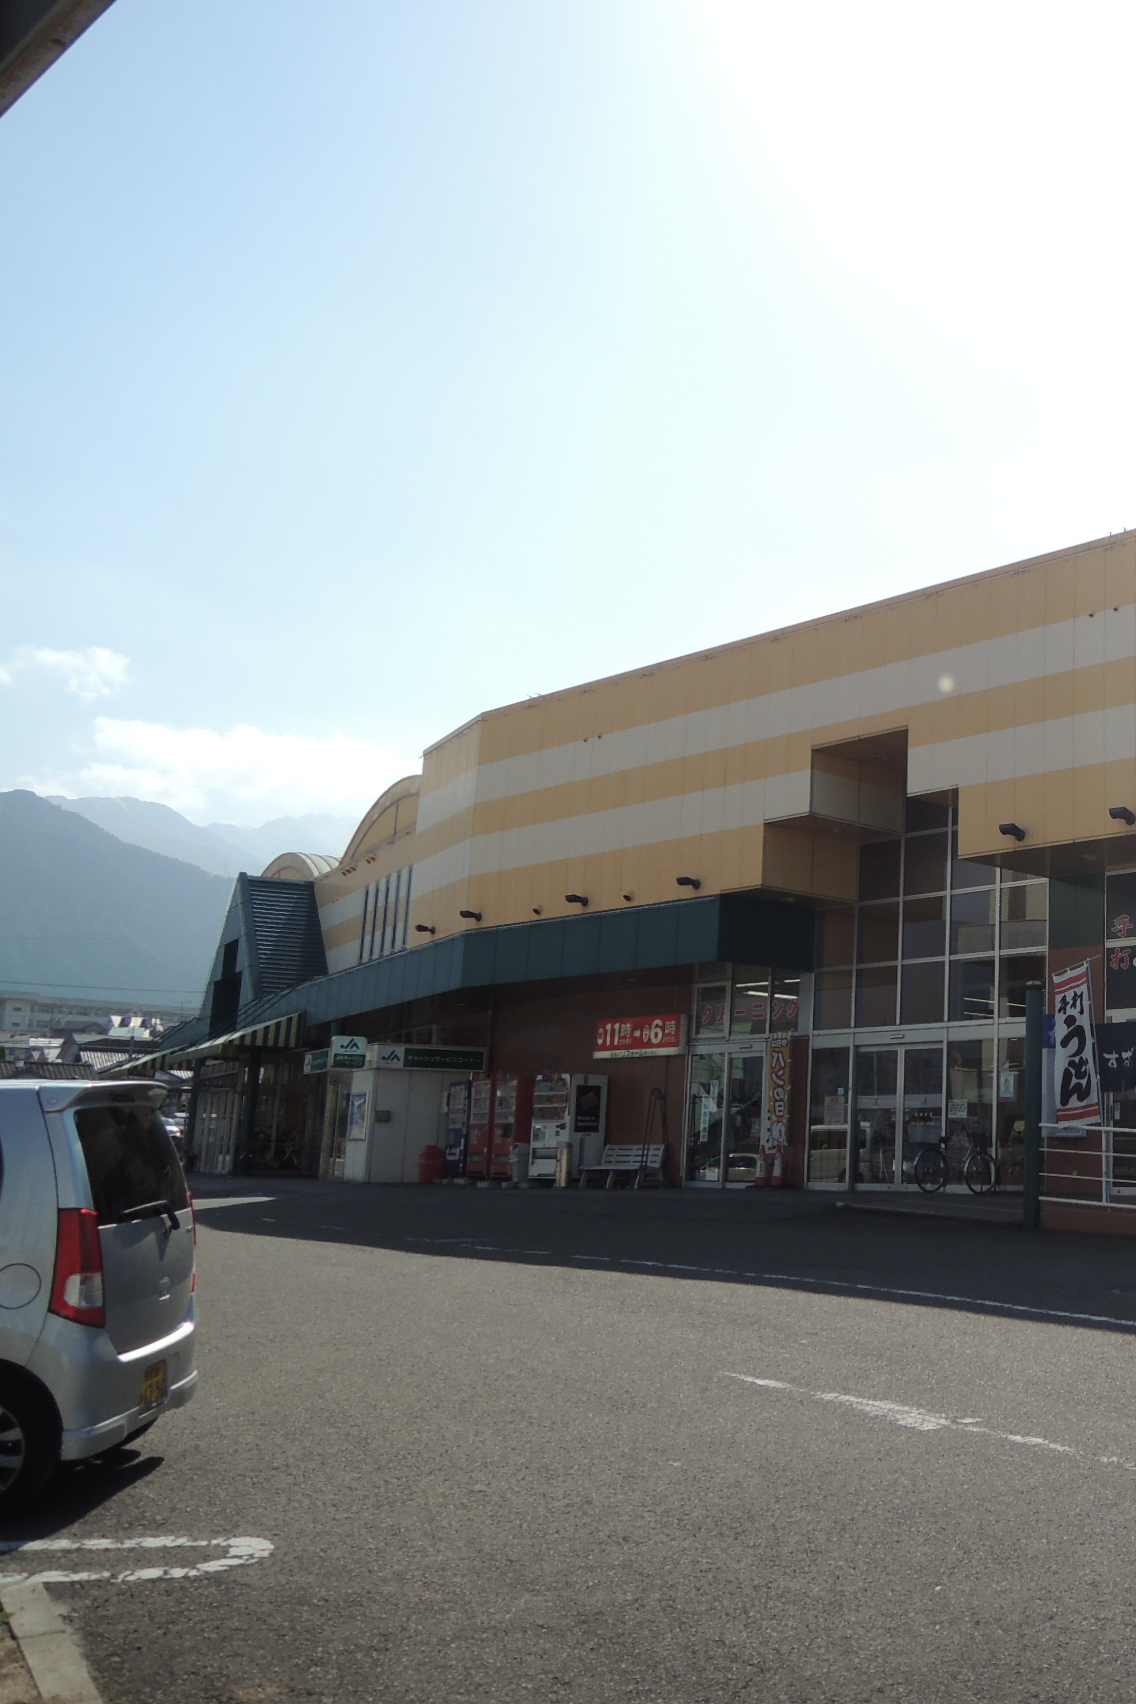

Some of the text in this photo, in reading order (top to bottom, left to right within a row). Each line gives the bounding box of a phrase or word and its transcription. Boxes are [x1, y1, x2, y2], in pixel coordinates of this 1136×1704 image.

[1109, 913, 1134, 970] 手打
[1057, 991, 1084, 1015] 手打
[1060, 1015, 1092, 1107] うどん
